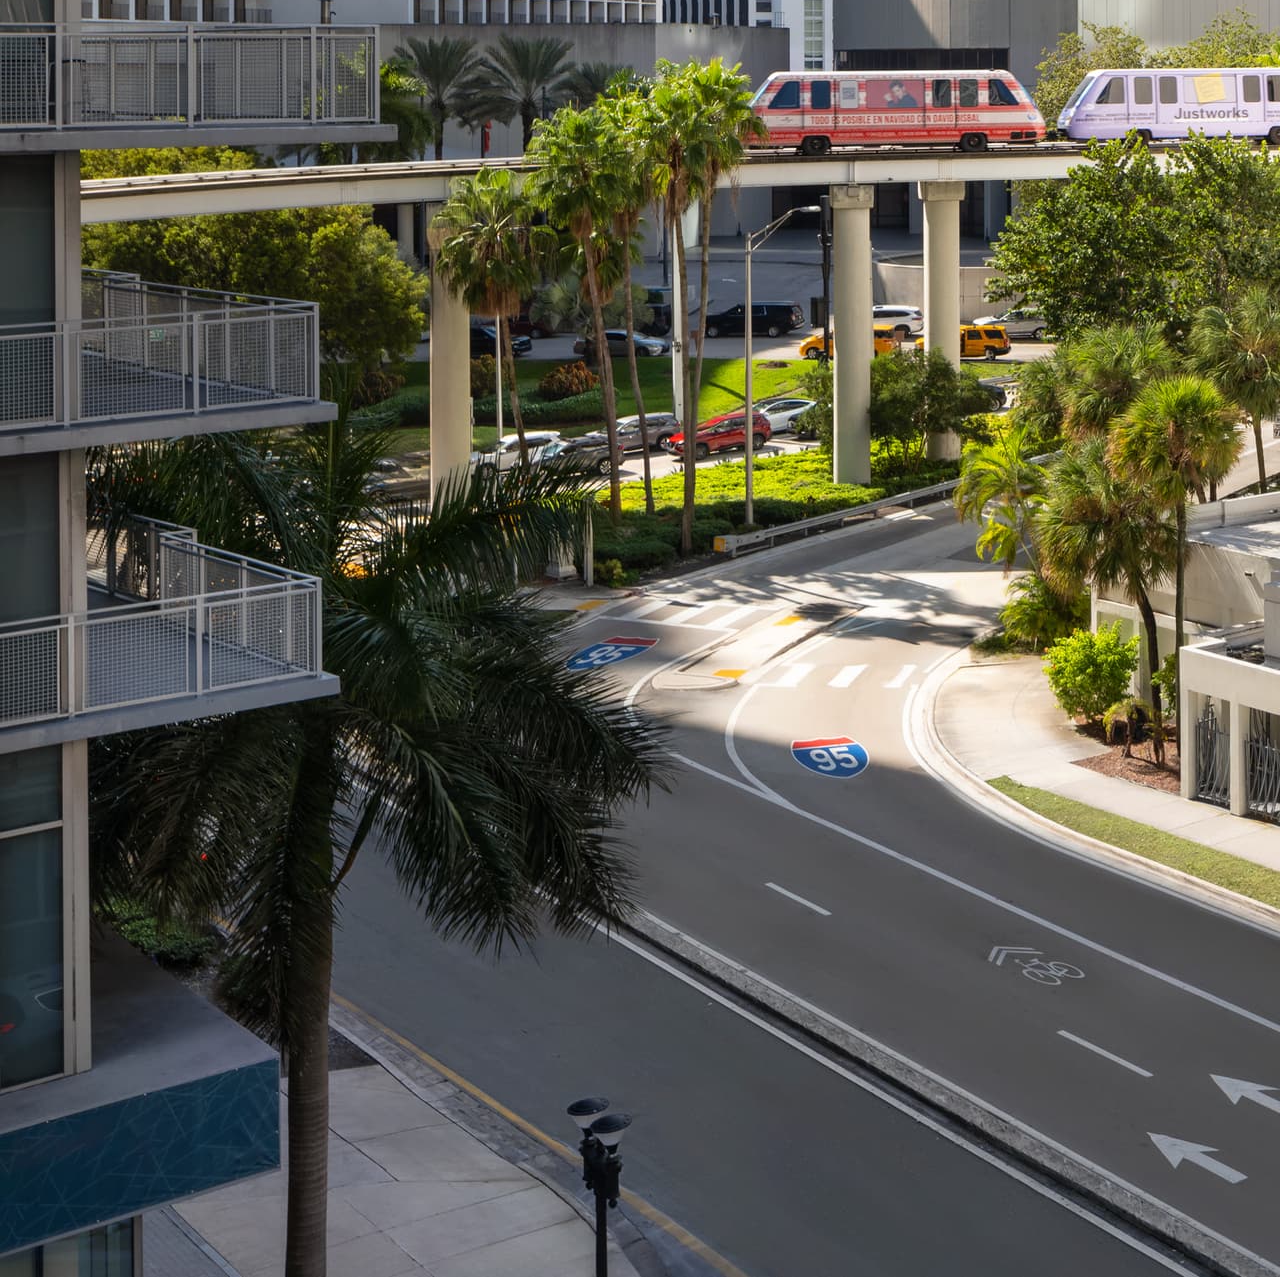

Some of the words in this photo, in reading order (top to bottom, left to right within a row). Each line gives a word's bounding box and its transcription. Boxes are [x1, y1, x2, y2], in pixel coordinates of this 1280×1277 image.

[811, 115, 829, 125] TODO
[831, 115, 841, 124] ES
[842, 115, 872, 124] POSIBLE
[873, 115, 883, 124] EN
[884, 115, 914, 124] NAVIDAD
[917, 114, 931, 123] CON
[932, 114, 954, 123] DAVID
[956, 113, 980, 122] BISBAL
[1174, 107, 1249, 121] Justworks
[575, 645, 636, 665] 95
[809, 746, 859, 771] 95
